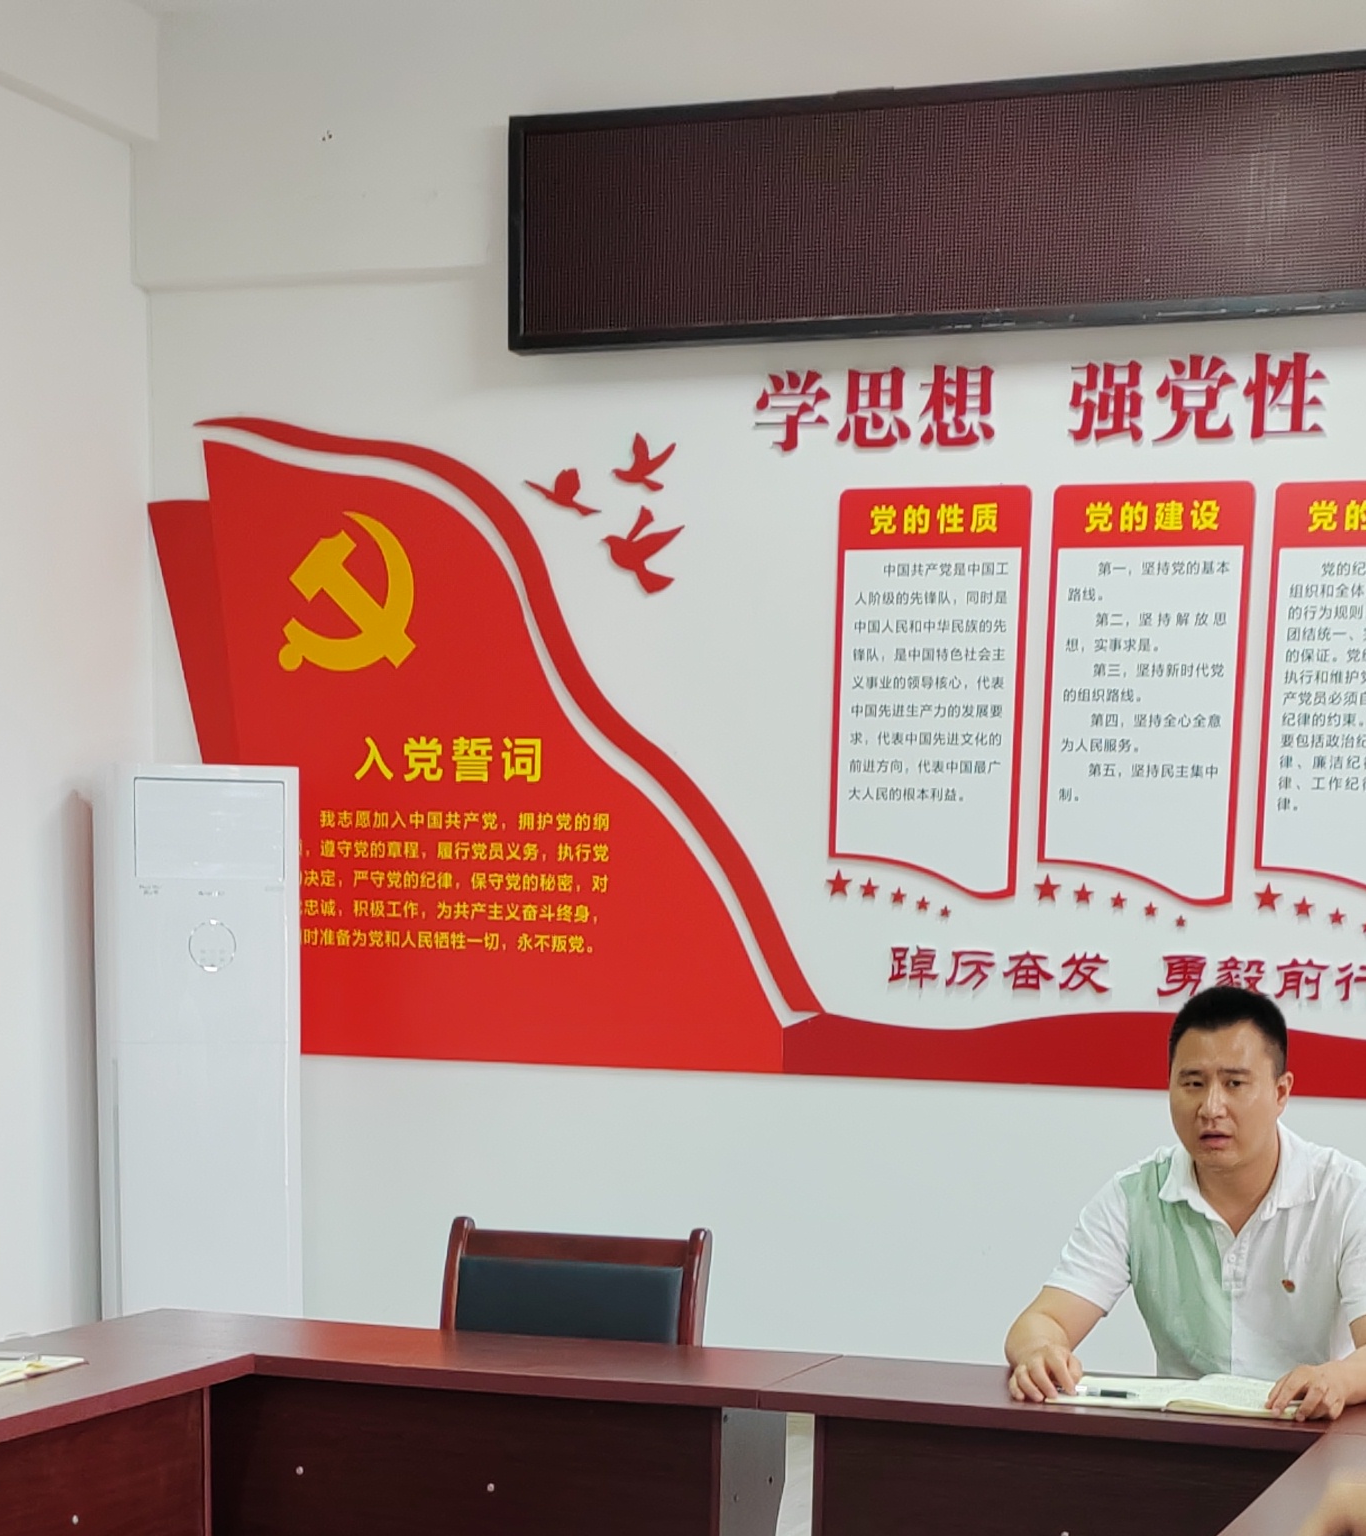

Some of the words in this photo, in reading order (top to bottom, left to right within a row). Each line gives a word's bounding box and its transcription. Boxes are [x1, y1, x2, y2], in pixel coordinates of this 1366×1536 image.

[755, 363, 996, 452] 学思想
[1068, 351, 1329, 447] 强党性
[870, 503, 998, 534] 党的性质
[1085, 500, 1220, 532] 党的建设
[883, 563, 1009, 577] 中国共产党是中国工
[1098, 560, 1230, 576] 第一，坚持党的基本
[855, 591, 1008, 606] 人阶级的先锋队，同时是
[1067, 587, 1104, 602] 路线。
[854, 619, 1007, 634] 中国人民和中华民族的先
[1095, 612, 1228, 628] 第二，坚持解放思
[1065, 638, 1159, 653] 想，实事求是。
[853, 647, 1005, 662] 锋队，是中国特色社会主
[1093, 663, 1224, 678] 第三，坚持新时代党
[851, 675, 1004, 690] 义事业的领导核心，代表
[1063, 688, 1141, 703] 的组织路线。
[851, 703, 1003, 718] 中国先进生产力的发展要
[1090, 713, 1221, 728] 第四，坚持全心全意
[850, 731, 1002, 746] 求，代表中国先进文化的
[1060, 738, 1139, 753] 为人民服务。
[354, 736, 543, 782] 入党誓词
[849, 759, 1001, 774] 前进方向，代表中国最广
[1088, 763, 1218, 778] 第五，坚持民主集中
[848, 787, 964, 802] 大人民的根本利益。
[1058, 788, 1080, 802] 制。
[1277, 797, 1299, 812] 律。
[320, 810, 610, 832] 我志愿加入中国共产党，拥护党的纲
[300, 839, 609, 862] ，遵守党的章程，履行党员义务，执行党
[300, 869, 609, 893] 决定，严守党的纪律，保守党的秘密，对
[300, 898, 599, 924] 忠诚，积极工作，为共产主义奋斗终身，
[300, 928, 594, 953] 时准备为党和人民牺牲一切，永不叛党。
[888, 945, 1110, 993] 踔厉奋发
